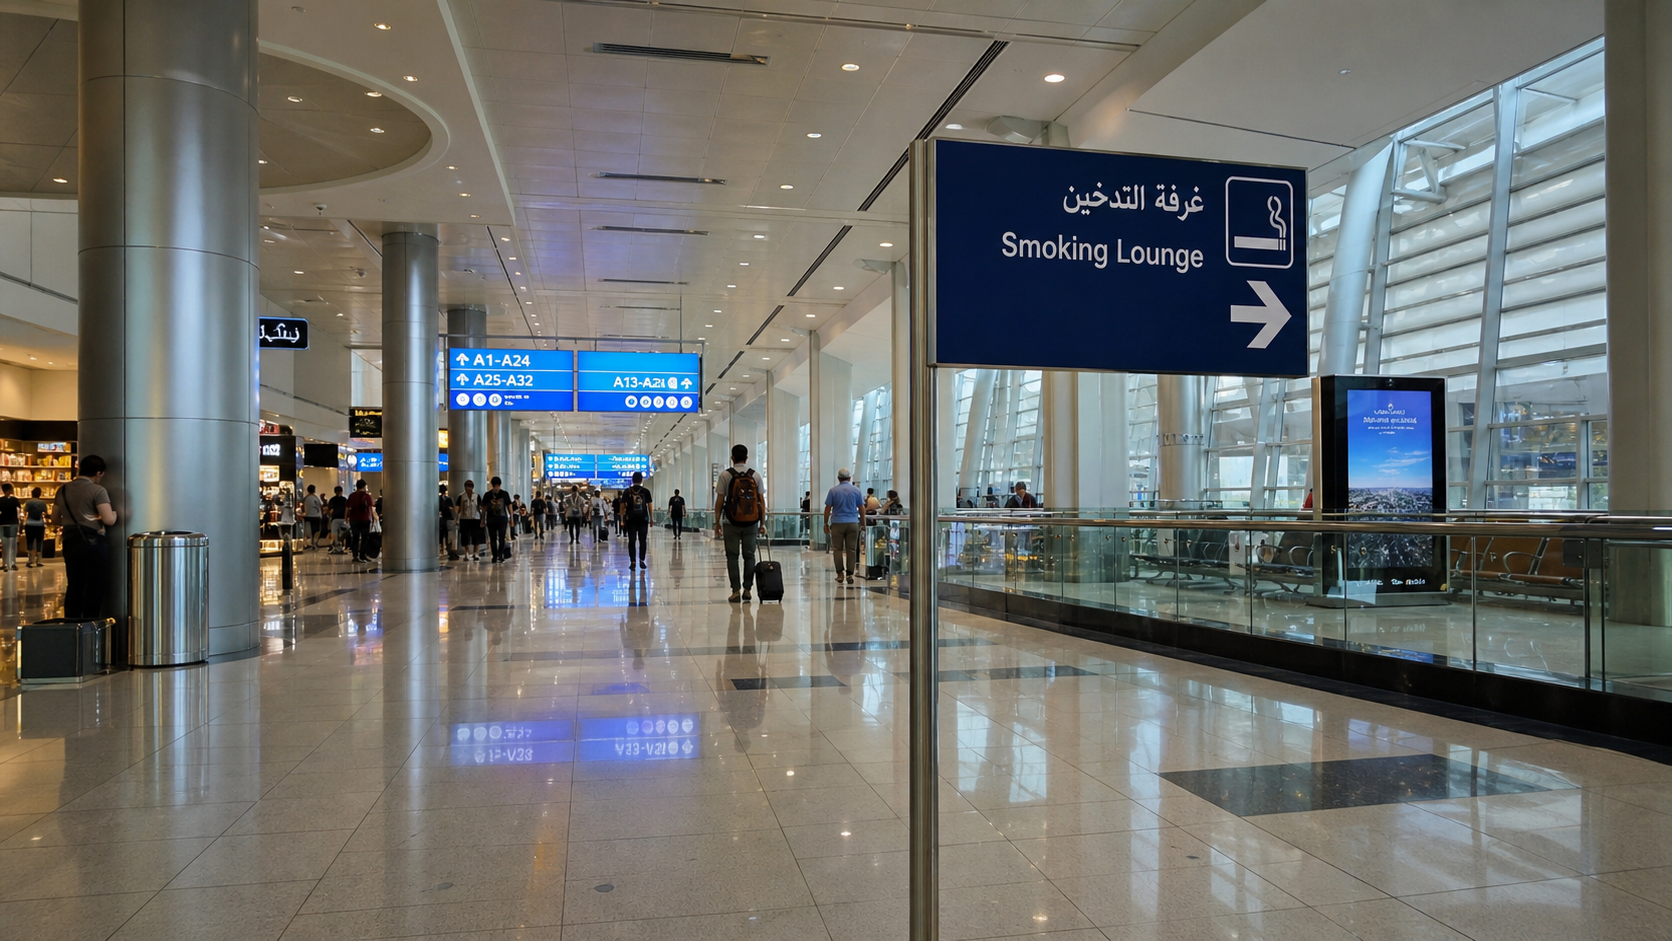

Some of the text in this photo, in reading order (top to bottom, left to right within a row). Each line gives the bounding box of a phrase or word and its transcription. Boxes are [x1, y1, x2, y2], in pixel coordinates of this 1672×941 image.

[1063, 181, 1204, 221] غرفة التدخين
[1001, 231, 1204, 273] Smoking Lounge
[473, 353, 531, 367] A1-A24
[473, 373, 533, 387] A25-A32
